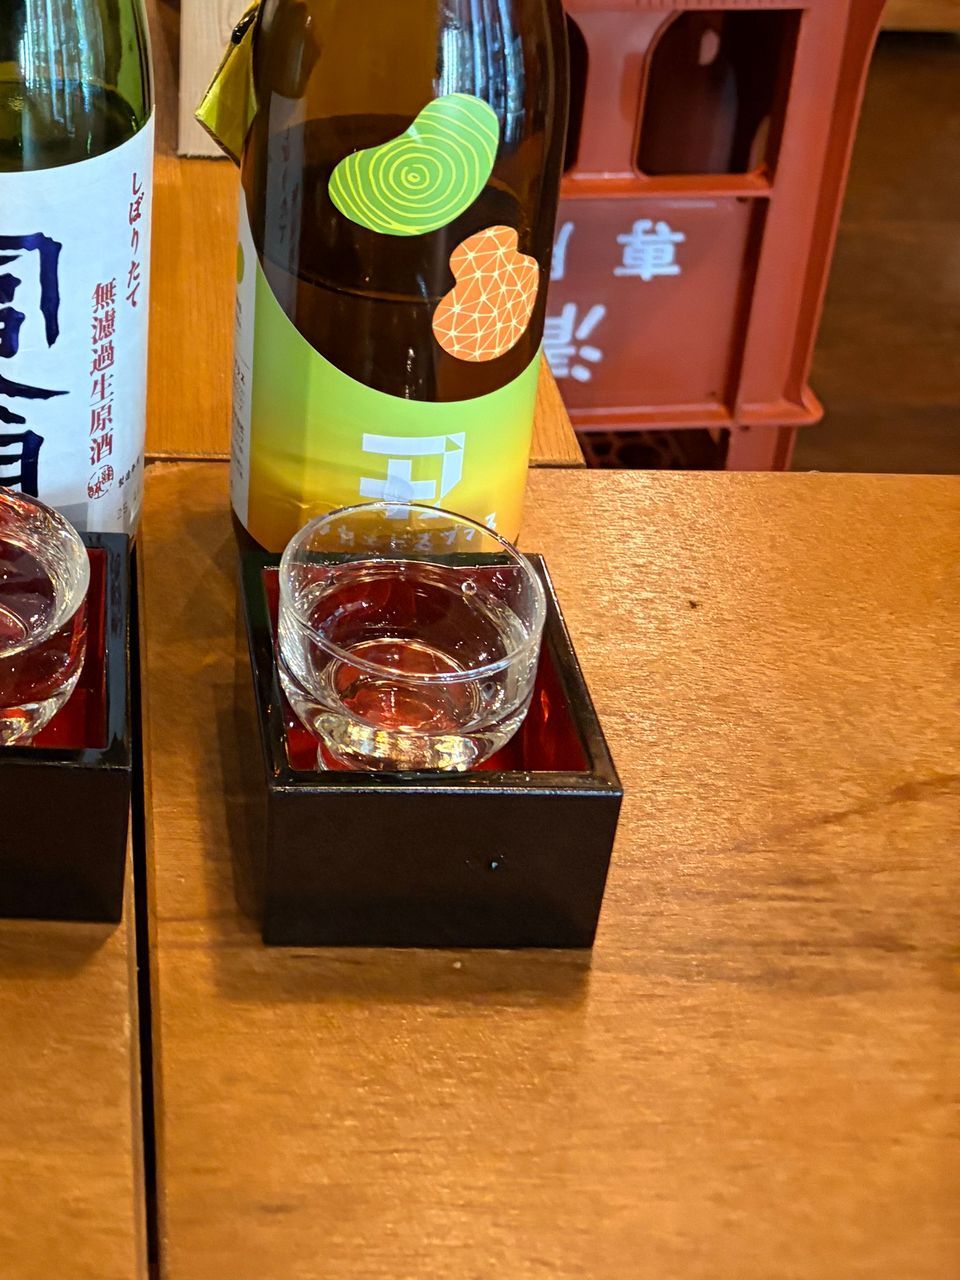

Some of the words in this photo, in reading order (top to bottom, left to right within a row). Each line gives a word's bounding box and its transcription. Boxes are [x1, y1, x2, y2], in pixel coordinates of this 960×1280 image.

[125, 172, 145, 308] しぼりたて
[88, 277, 118, 467] 無濾過生原酒
